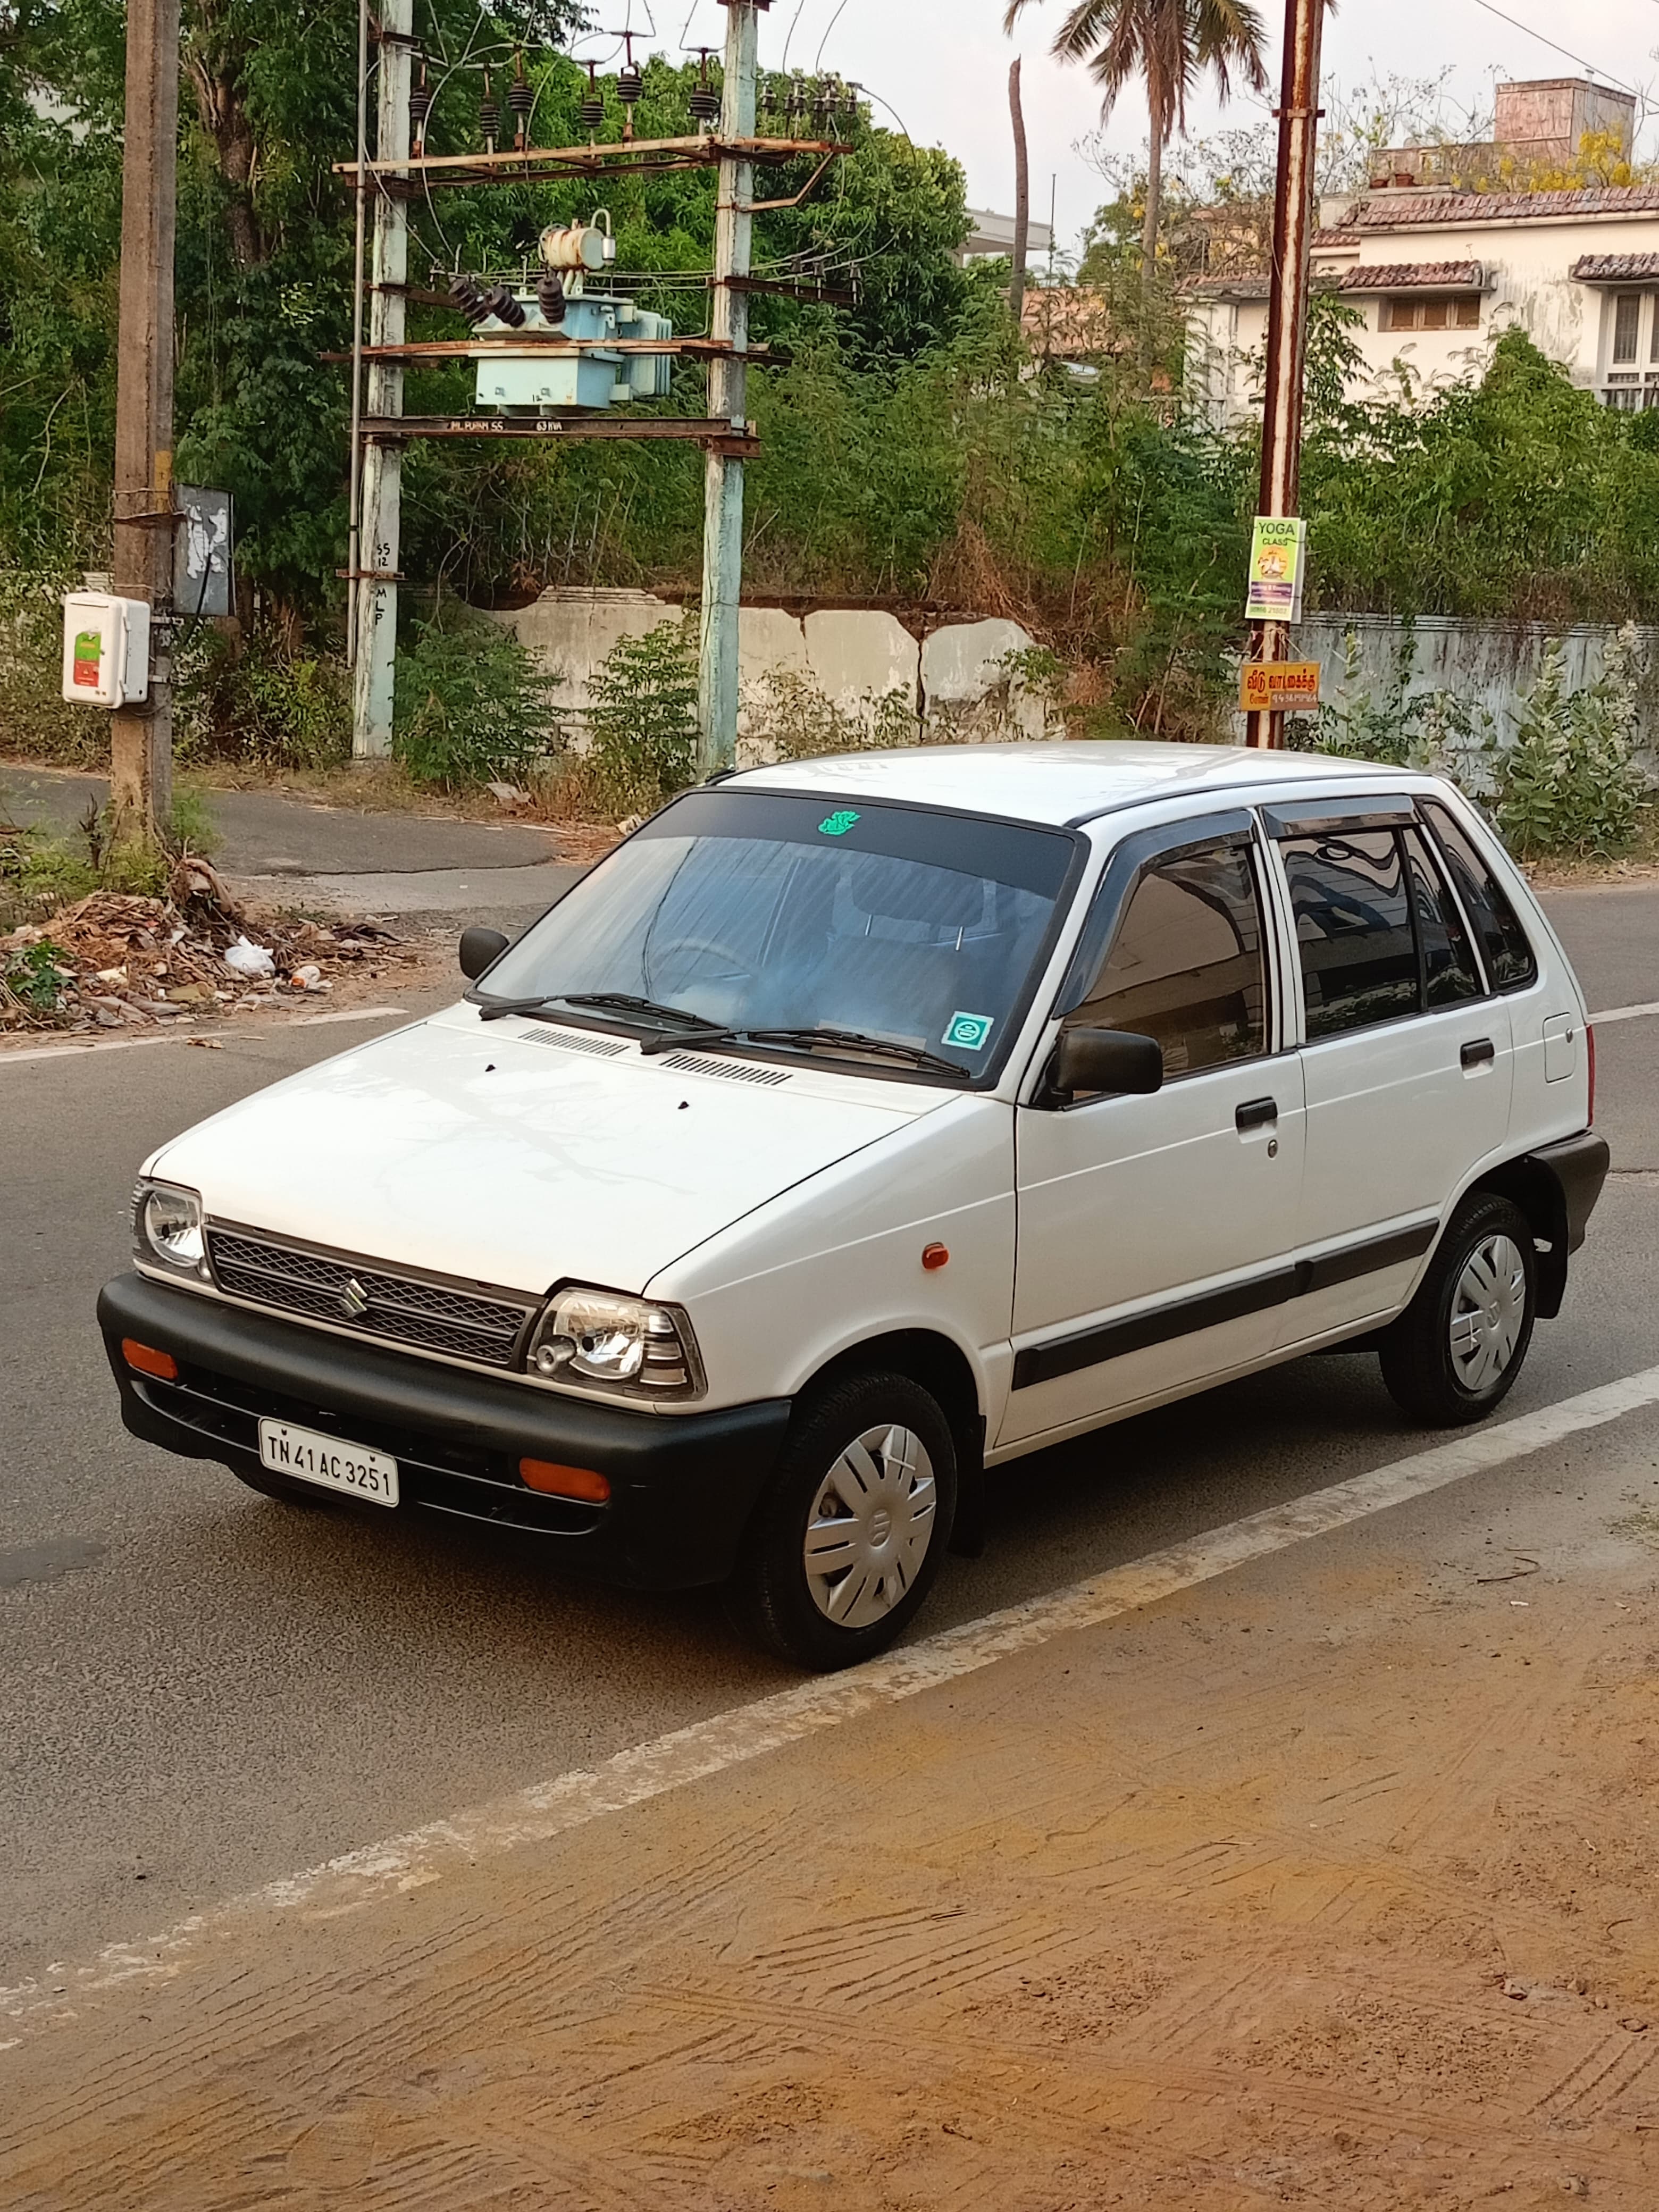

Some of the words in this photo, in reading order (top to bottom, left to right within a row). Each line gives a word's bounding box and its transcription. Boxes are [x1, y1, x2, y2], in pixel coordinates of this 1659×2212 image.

[491, 421, 504, 430] SS
[536, 421, 547, 431] 63
[1259, 522, 1295, 535] YOGA
[1262, 538, 1288, 546] CLASS
[378, 557, 389, 567] 12
[1247, 669, 1266, 692] வீடு
